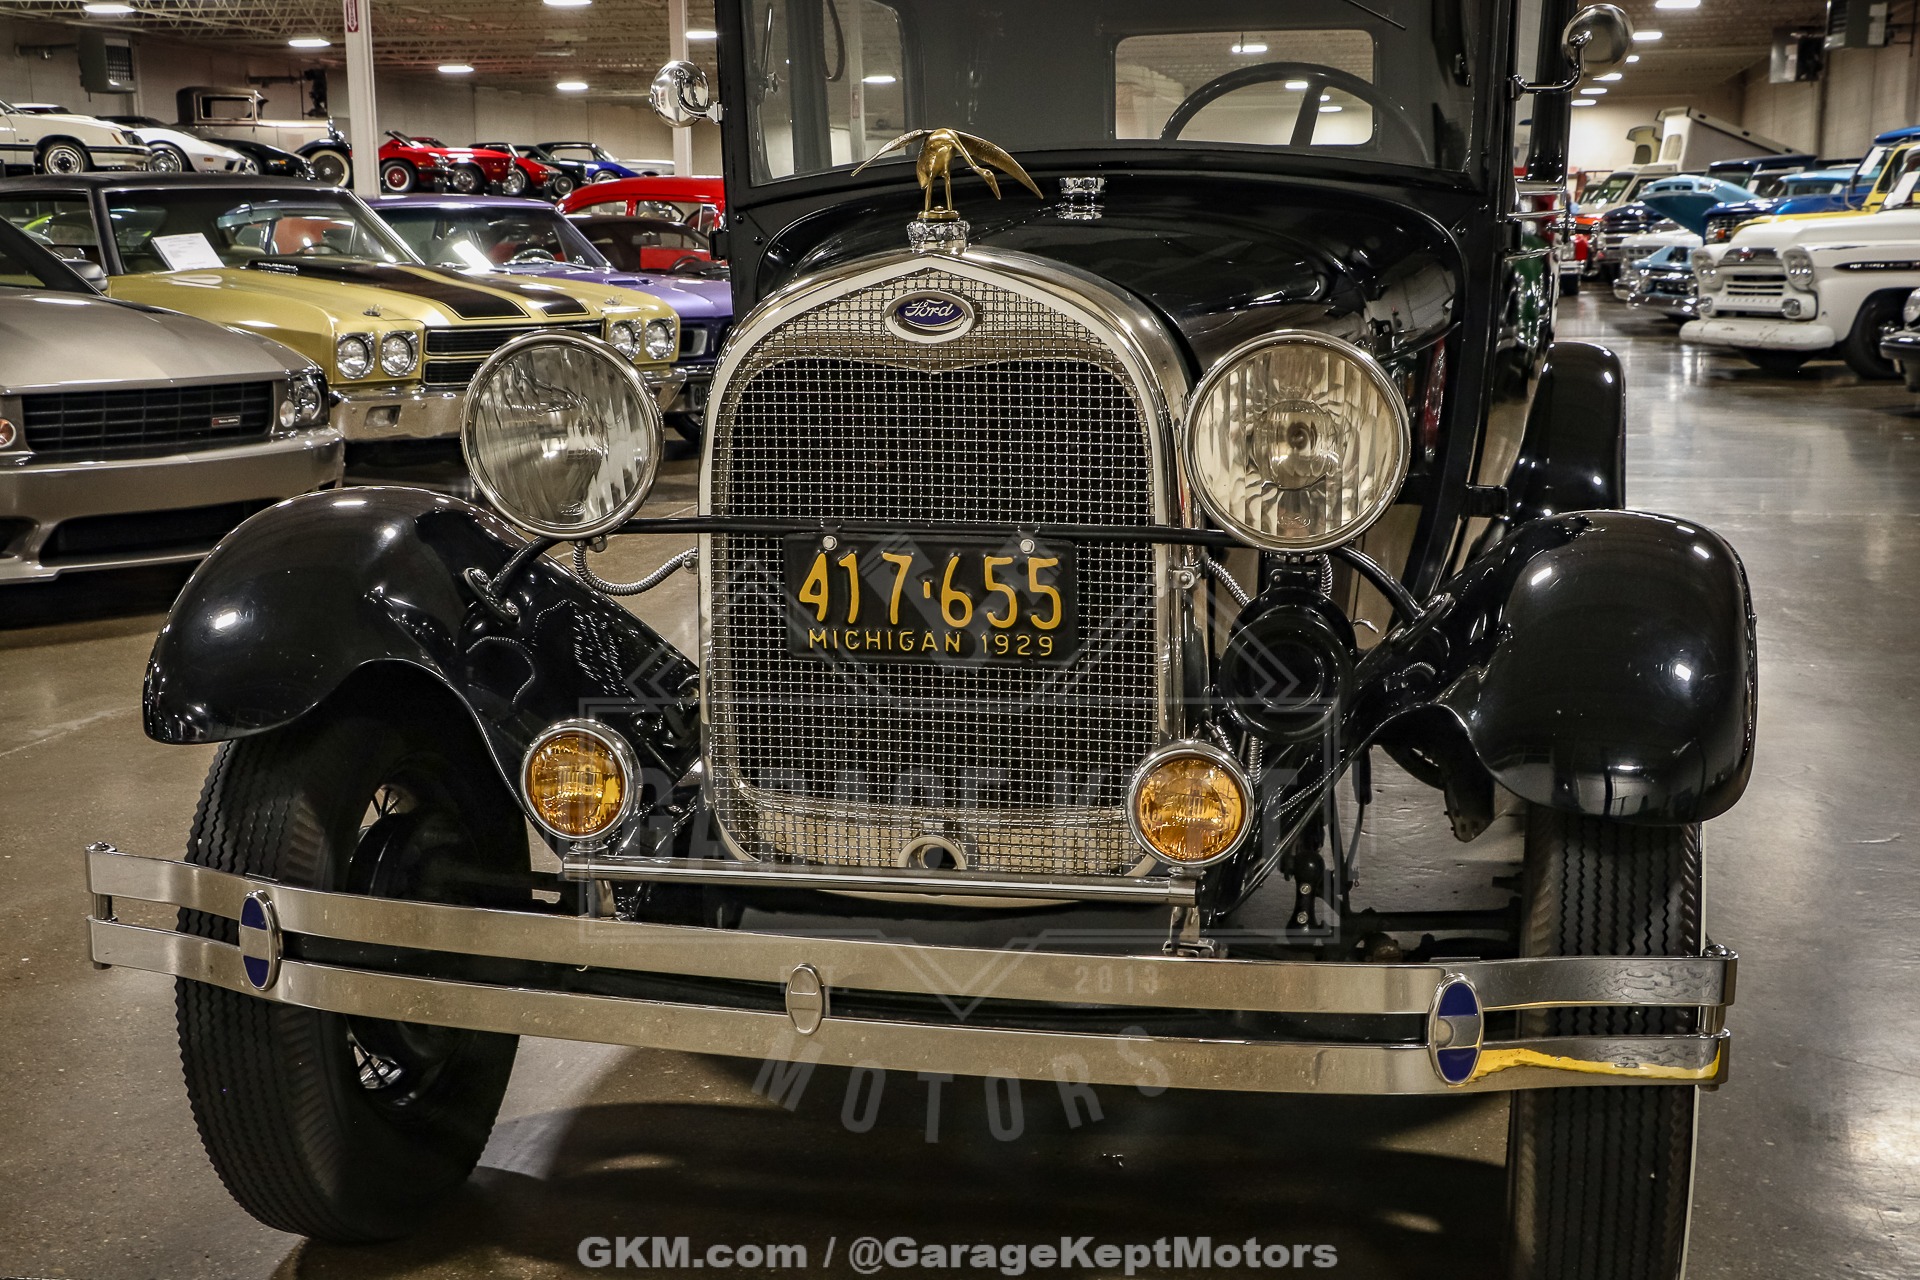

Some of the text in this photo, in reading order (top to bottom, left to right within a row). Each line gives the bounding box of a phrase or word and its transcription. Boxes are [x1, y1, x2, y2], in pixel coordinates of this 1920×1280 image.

[905, 299, 954, 317] Ford
[808, 630, 1054, 657] MICHIGAN 1929
